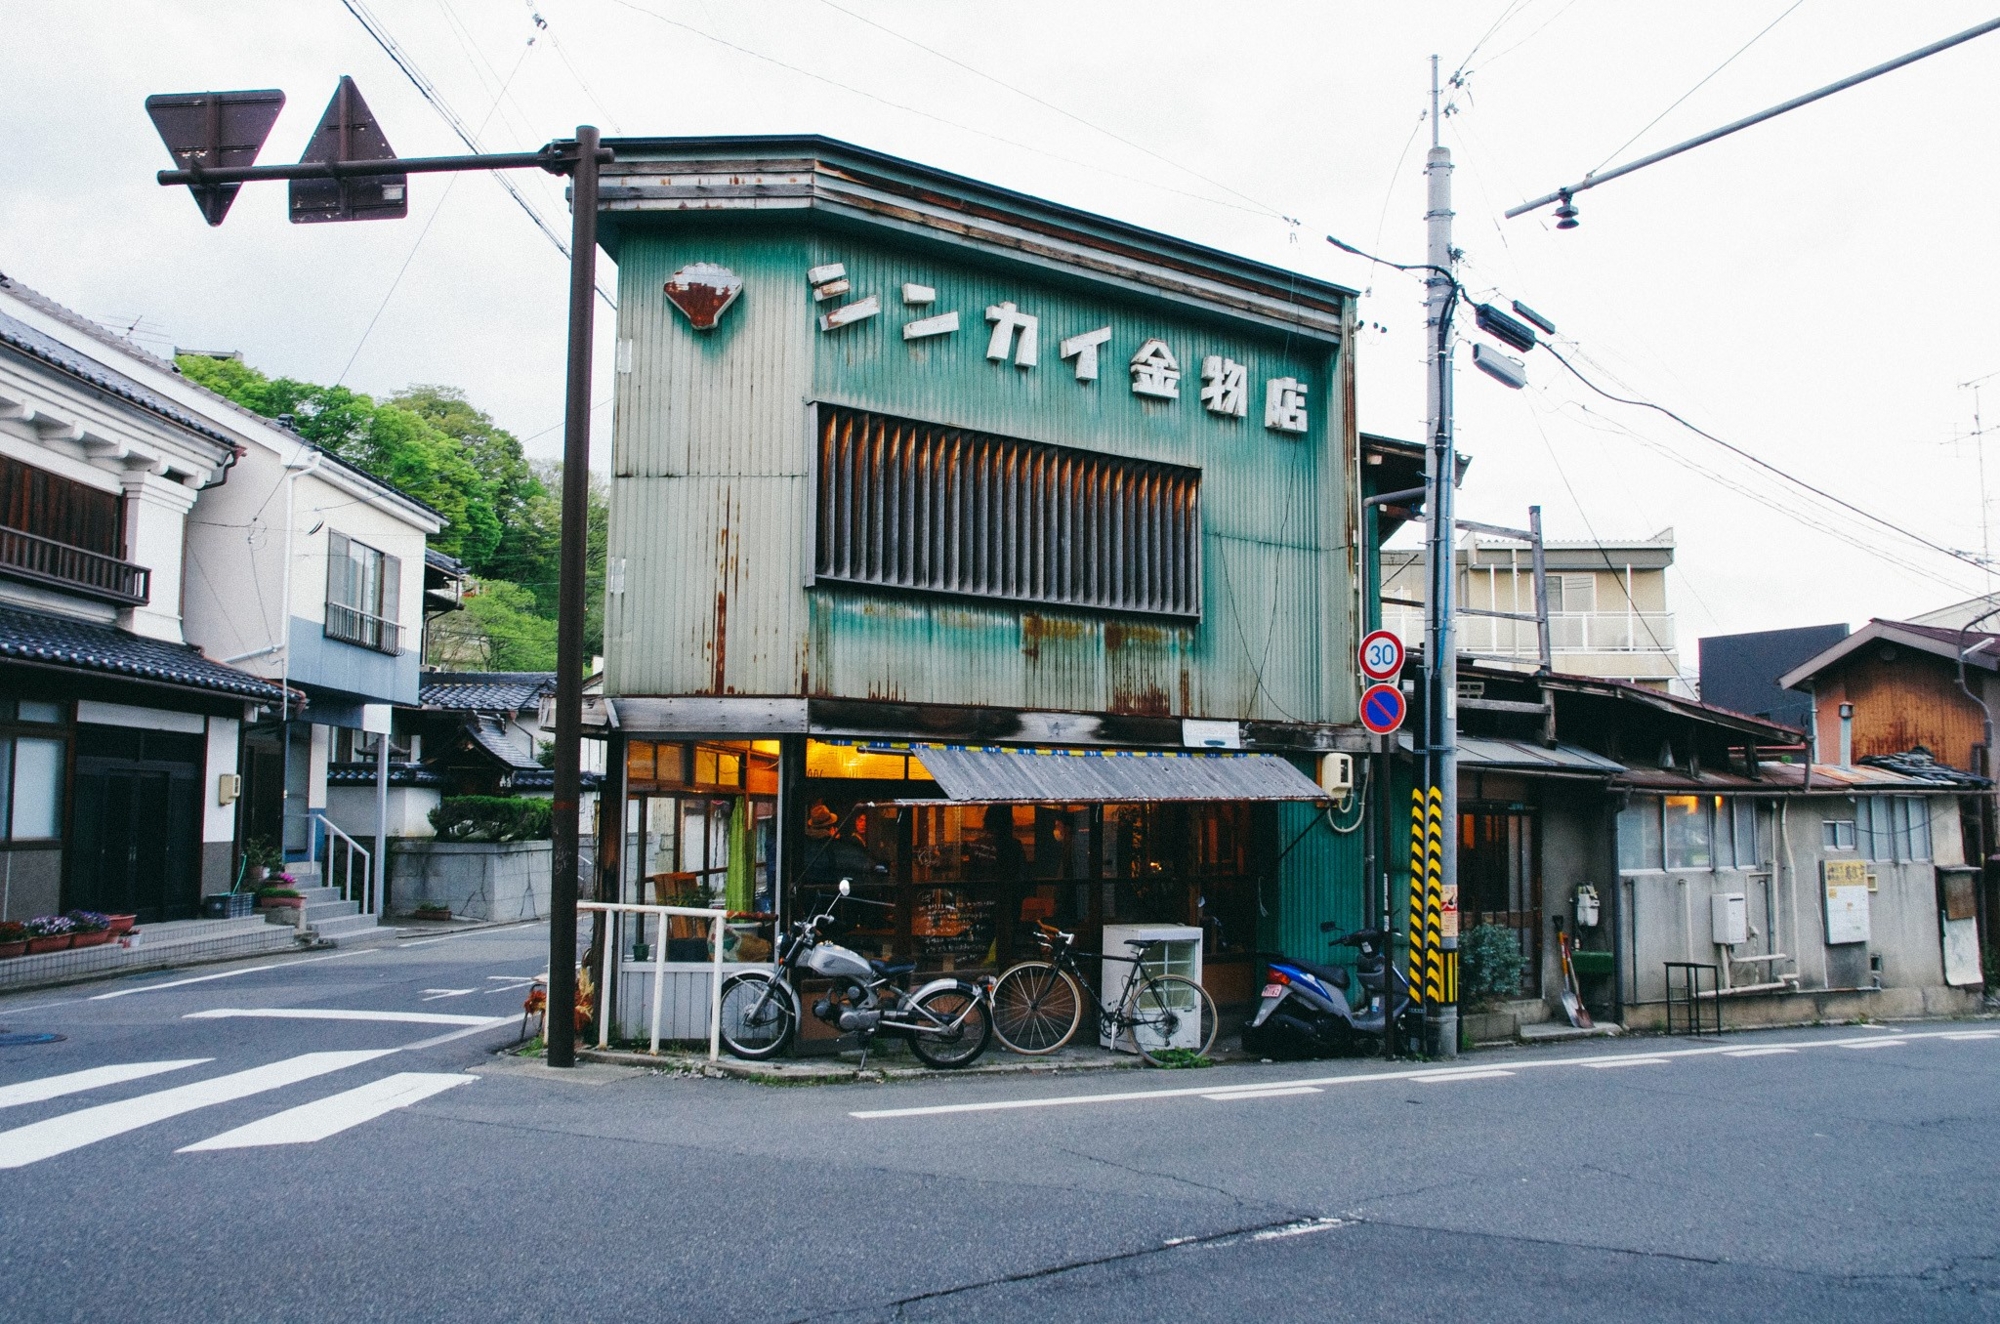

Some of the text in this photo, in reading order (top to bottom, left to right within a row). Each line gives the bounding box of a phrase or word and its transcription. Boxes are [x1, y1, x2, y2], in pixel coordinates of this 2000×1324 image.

[807, 262, 1308, 433] シンカイ金物店
[1370, 644, 1394, 666] 30
